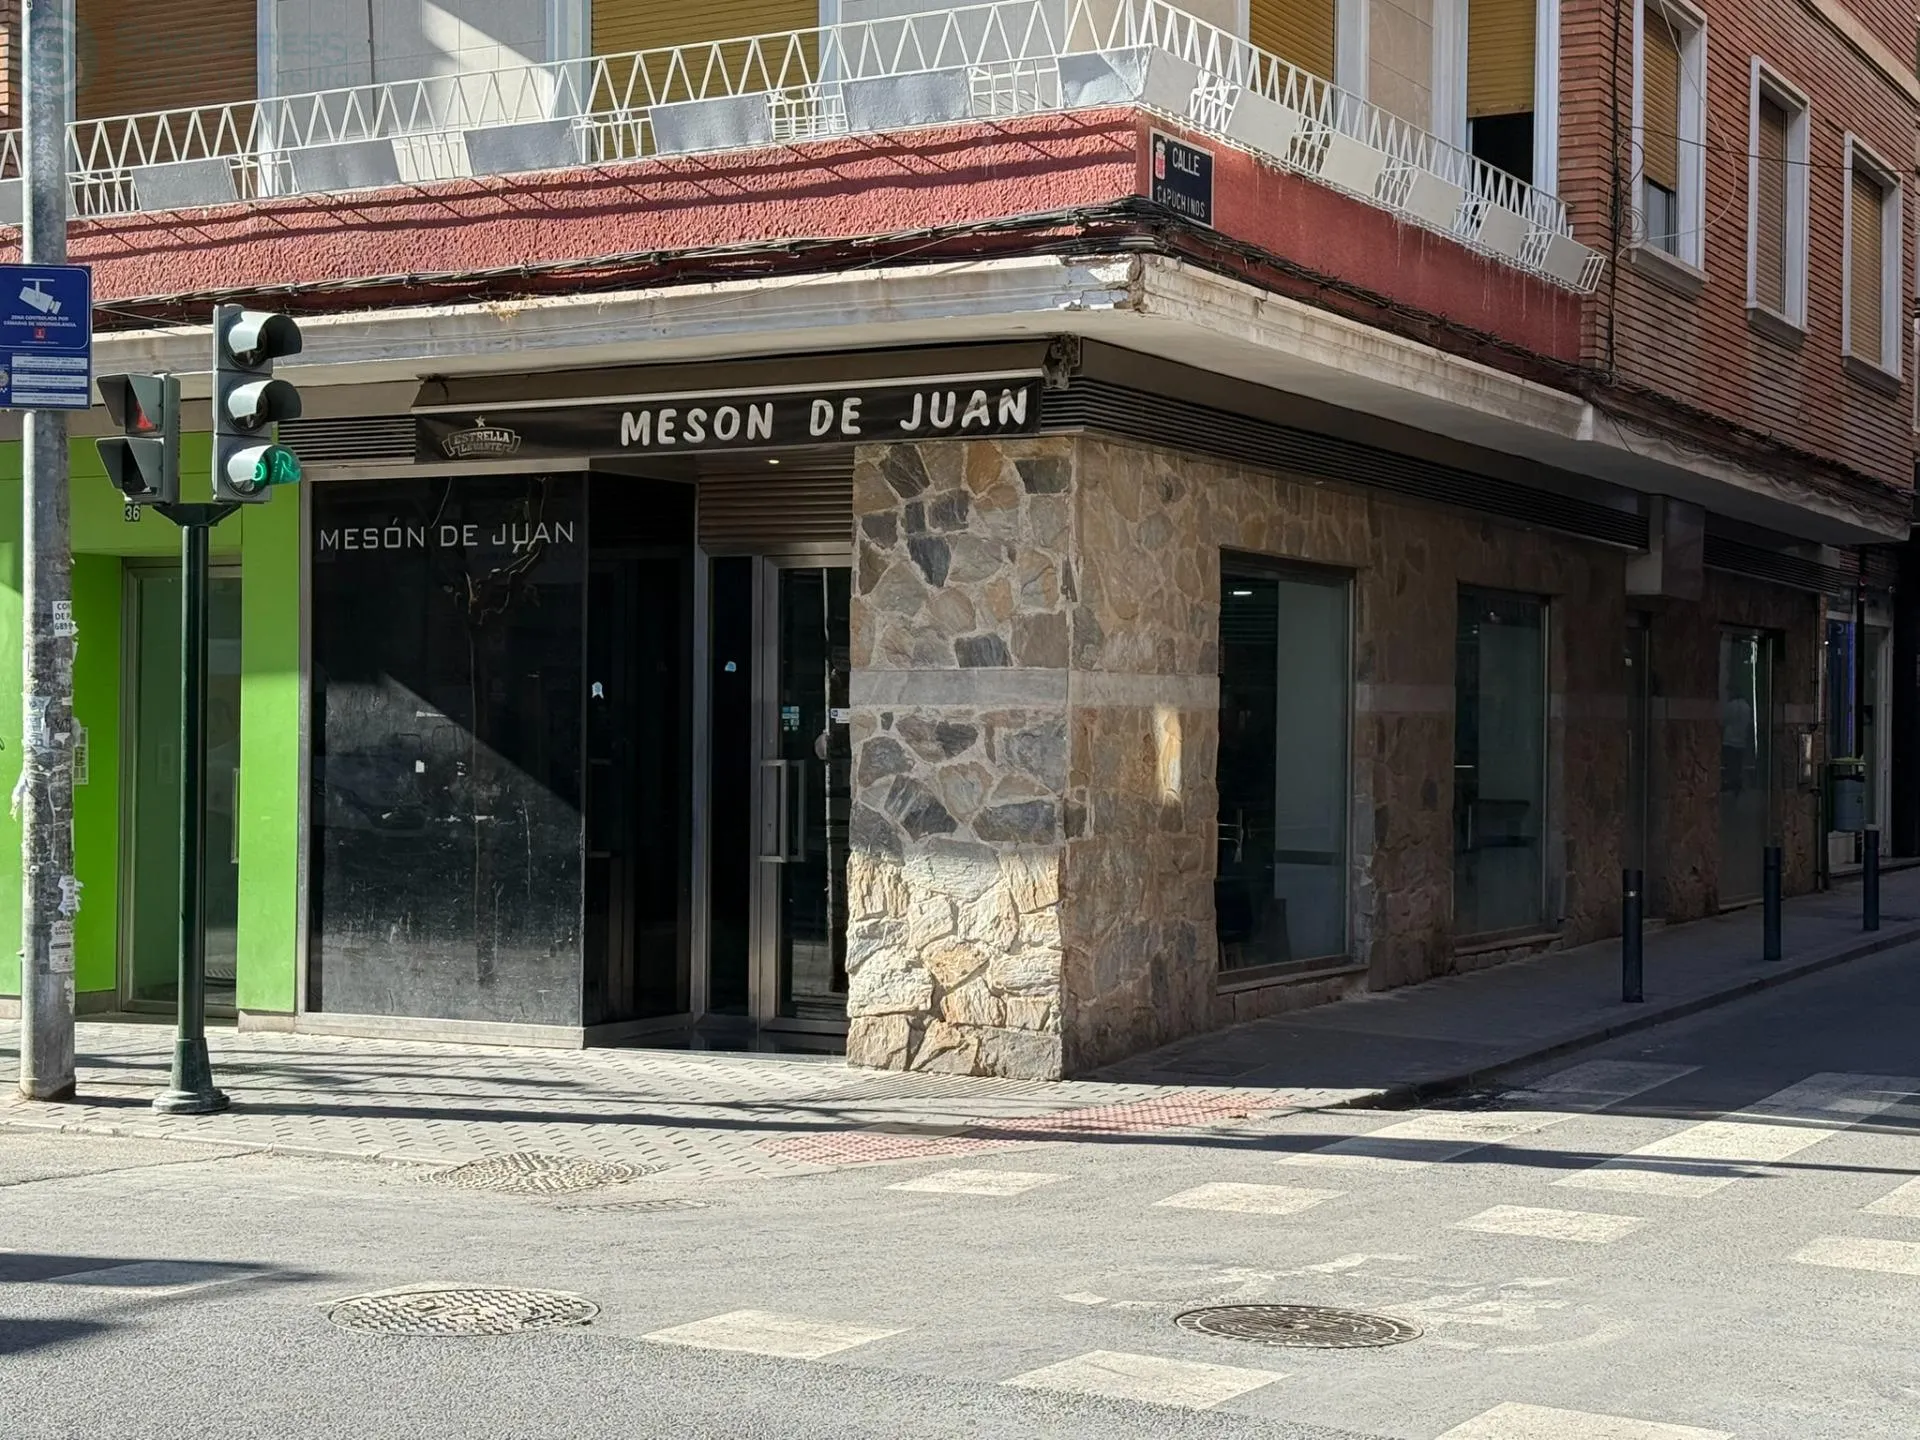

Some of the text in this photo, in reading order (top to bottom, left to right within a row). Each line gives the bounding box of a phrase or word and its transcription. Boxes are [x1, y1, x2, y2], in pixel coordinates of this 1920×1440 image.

[1171, 147, 1201, 177] CALLE
[1156, 186, 1206, 218] CAPUCHINOS
[620, 388, 1028, 447] MESON DE JUAN
[454, 430, 510, 445] ESTRELLA
[461, 442, 502, 453] LEVANTE
[125, 504, 141, 521] 36
[320, 517, 574, 550] MESÓN DE JUAN
